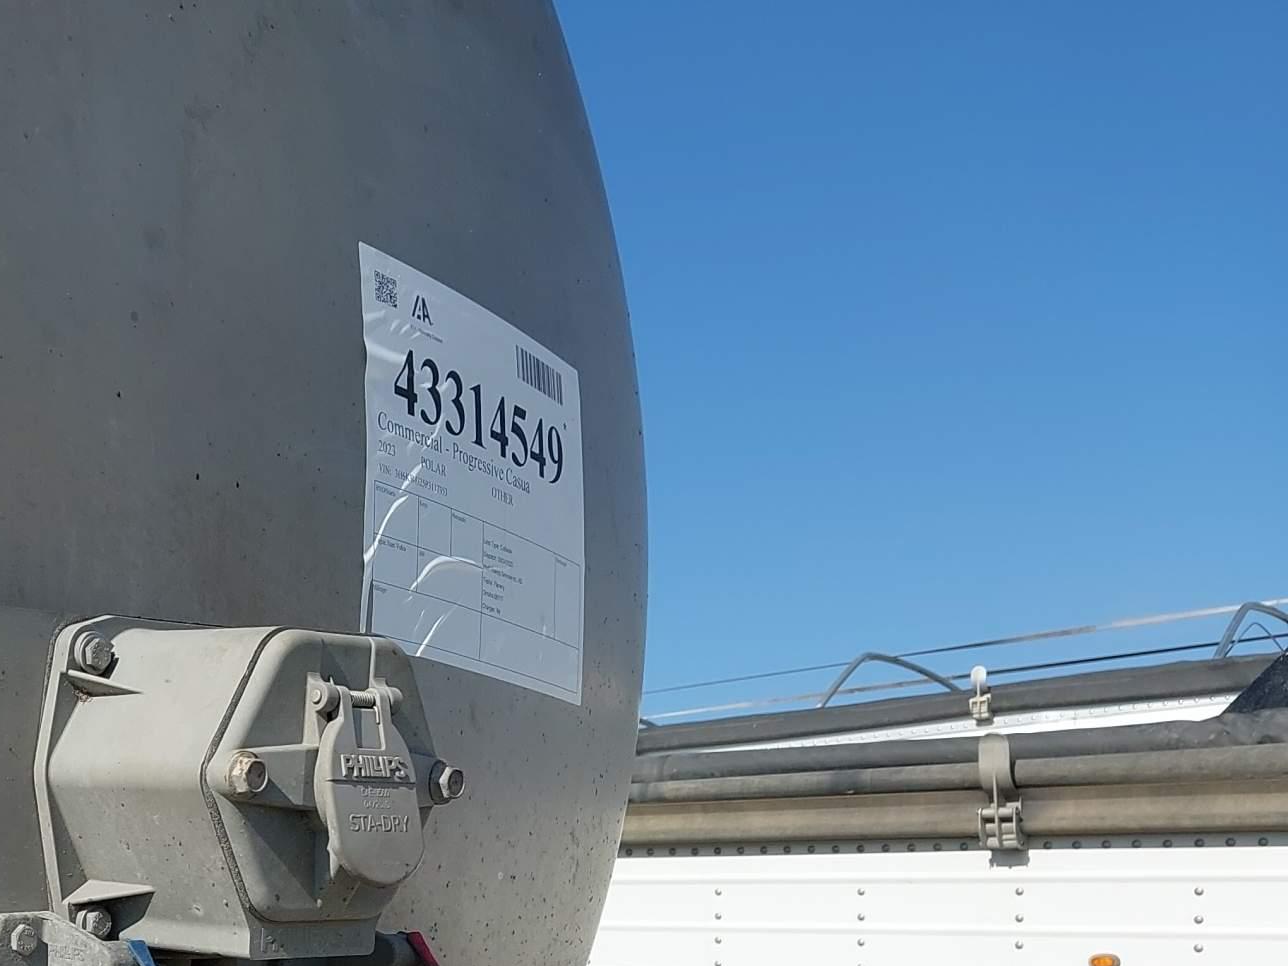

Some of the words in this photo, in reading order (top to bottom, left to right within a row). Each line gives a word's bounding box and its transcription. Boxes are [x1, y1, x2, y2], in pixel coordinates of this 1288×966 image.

[394, 349, 563, 485] 43314549
[378, 411, 443, 454] Commercial
[452, 442, 504, 481] Progressive
[506, 467, 531, 494] Casua
[421, 456, 447, 477] POLAR
[491, 487, 514, 506] OTHER
[340, 754, 409, 782] PHILLIPS
